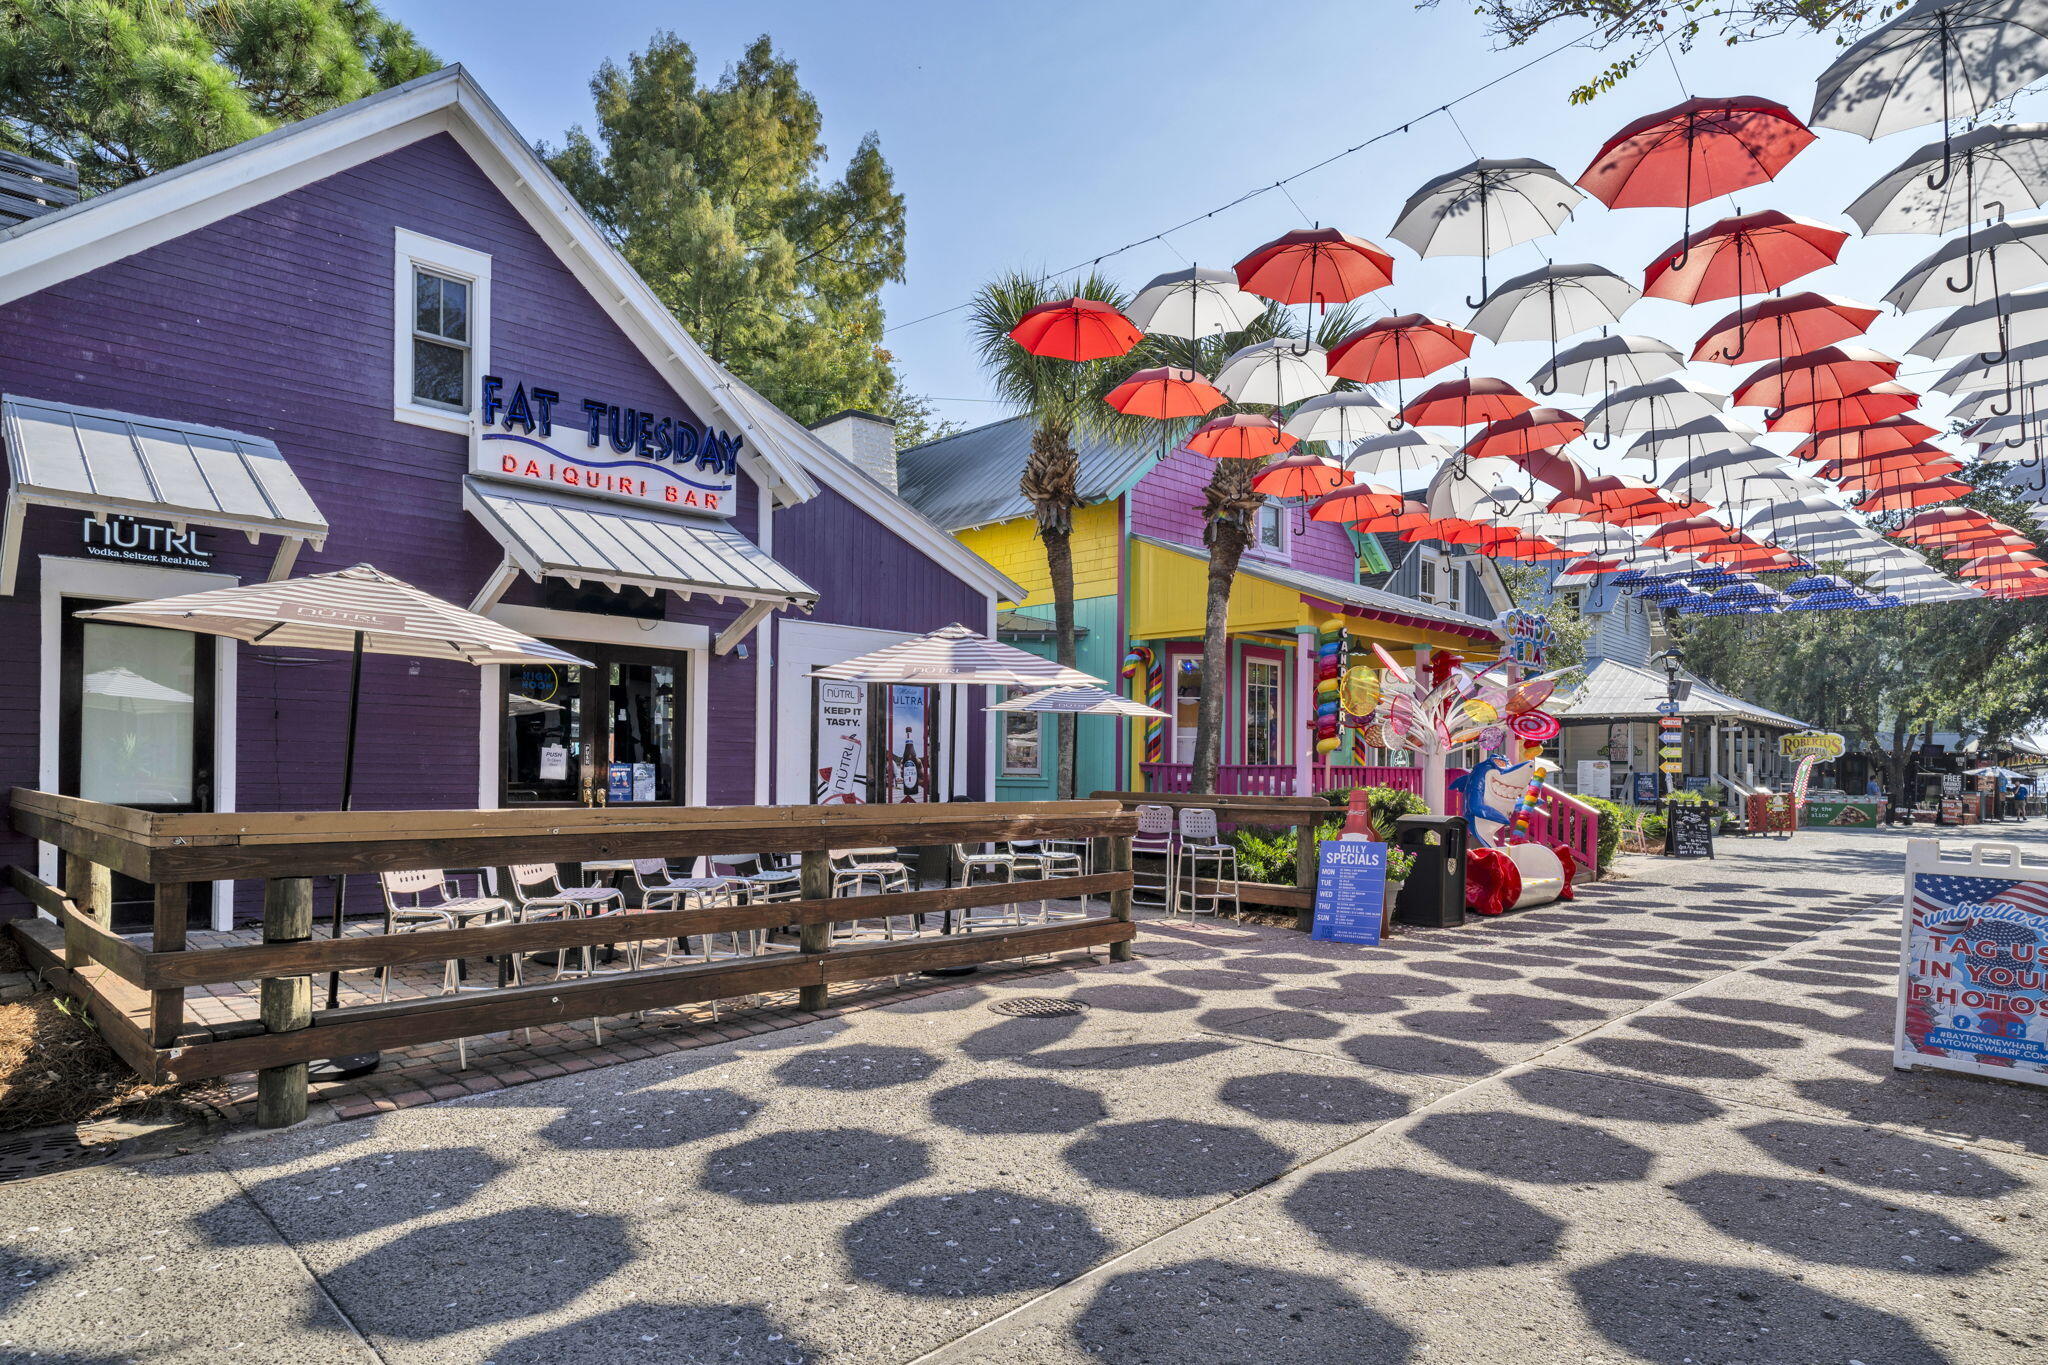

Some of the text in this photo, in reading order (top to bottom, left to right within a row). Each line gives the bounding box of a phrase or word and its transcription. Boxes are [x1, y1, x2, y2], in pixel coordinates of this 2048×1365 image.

[482, 375, 743, 475] FAT TUESDAY
[502, 454, 719, 510] DAIQUIRI BAR
[87, 546, 210, 568] Vodka. Seltzer. Real Juice.
[1508, 613, 1552, 644] CANDY
[1516, 641, 1541, 665] ERA
[522, 671, 552, 681] HIGH
[522, 681, 553, 690] NOON
[893, 696, 924, 705] ULTRA
[824, 706, 863, 716] KEEP IT
[826, 718, 861, 727] TASTY.
[1783, 738, 1842, 754] ROBERTO'S
[1340, 844, 1367, 853] DAILY
[1326, 852, 1379, 866] SPECIALS
[1321, 868, 1336, 876] MON
[1321, 879, 1332, 887] TUE
[1319, 890, 1333, 898] WED
[1318, 902, 1331, 910] THU
[1316, 913, 1330, 921] SUN
[1923, 902, 2027, 928] umbrella
[1928, 935, 1998, 959] TAG
[1919, 959, 2048, 991] IN YOU
[1939, 1031, 2040, 1051] #BAYTOWNEWHARF
